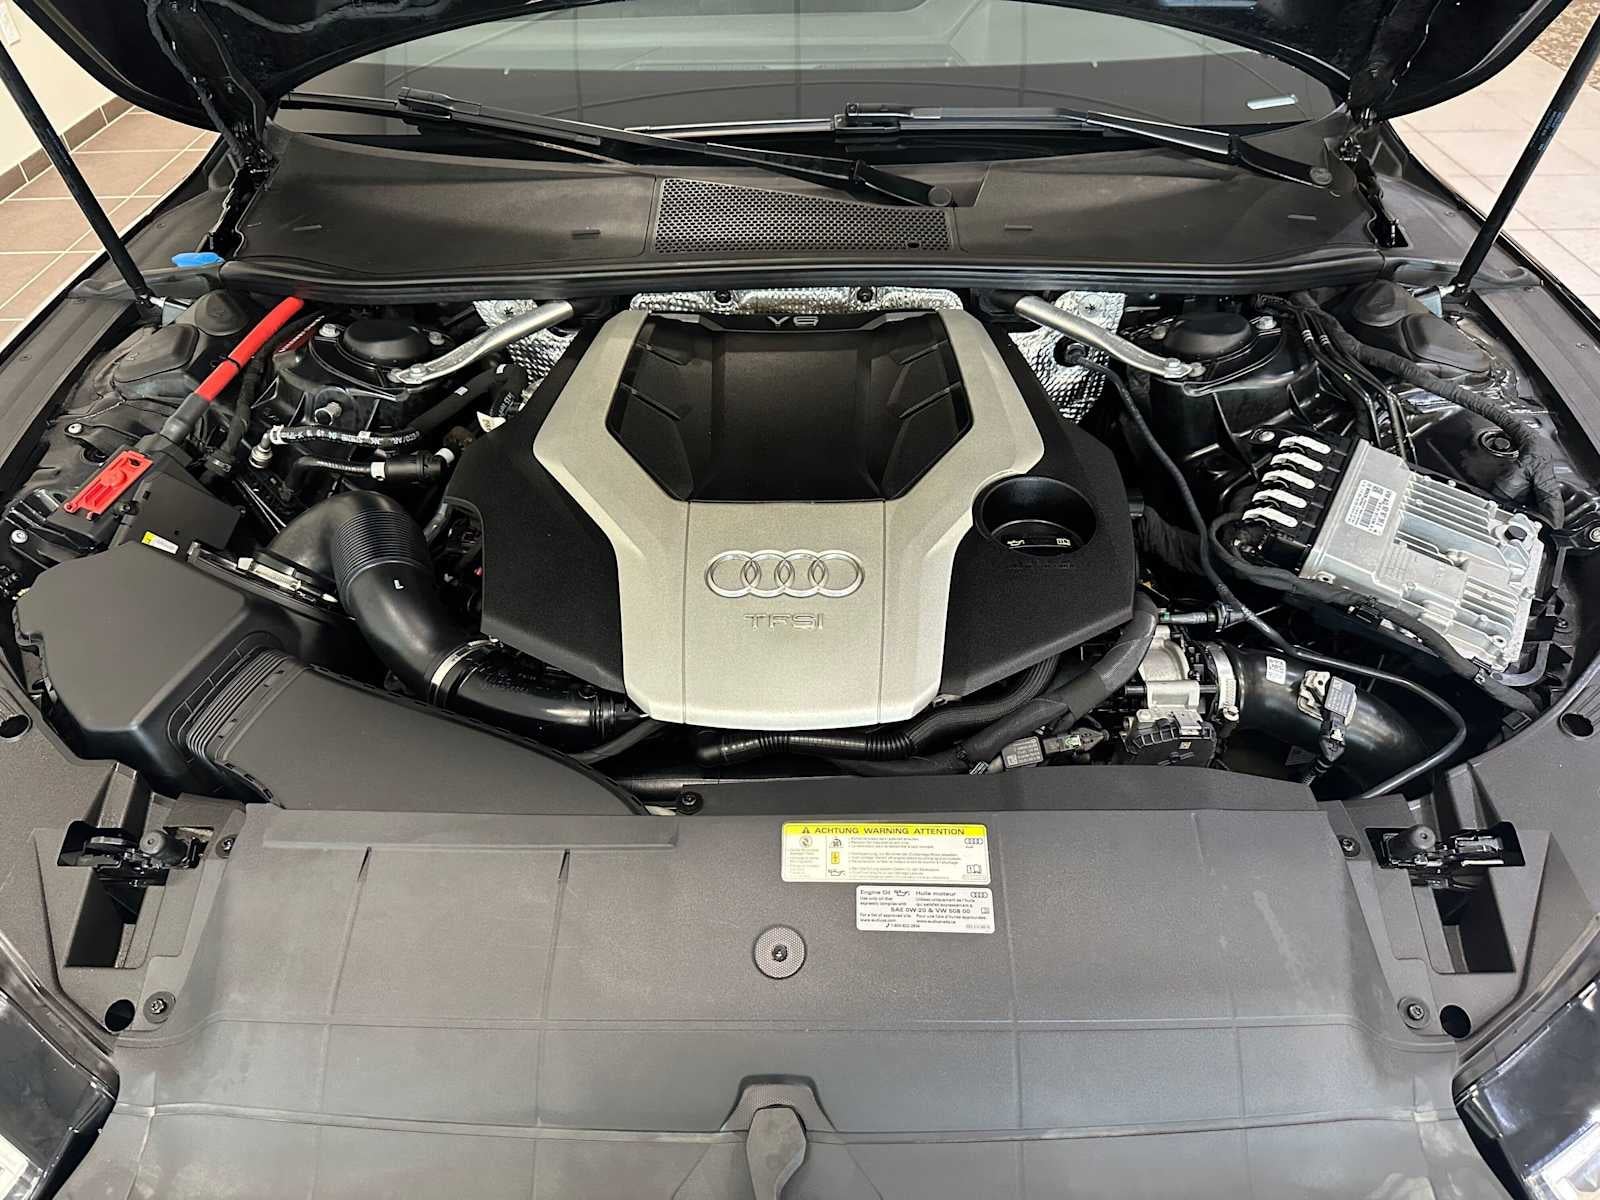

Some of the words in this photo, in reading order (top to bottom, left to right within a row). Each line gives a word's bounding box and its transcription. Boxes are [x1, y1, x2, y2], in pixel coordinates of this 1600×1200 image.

[767, 315, 819, 327] V6
[743, 613, 824, 632] TFSI
[864, 827, 910, 835] WARNING
